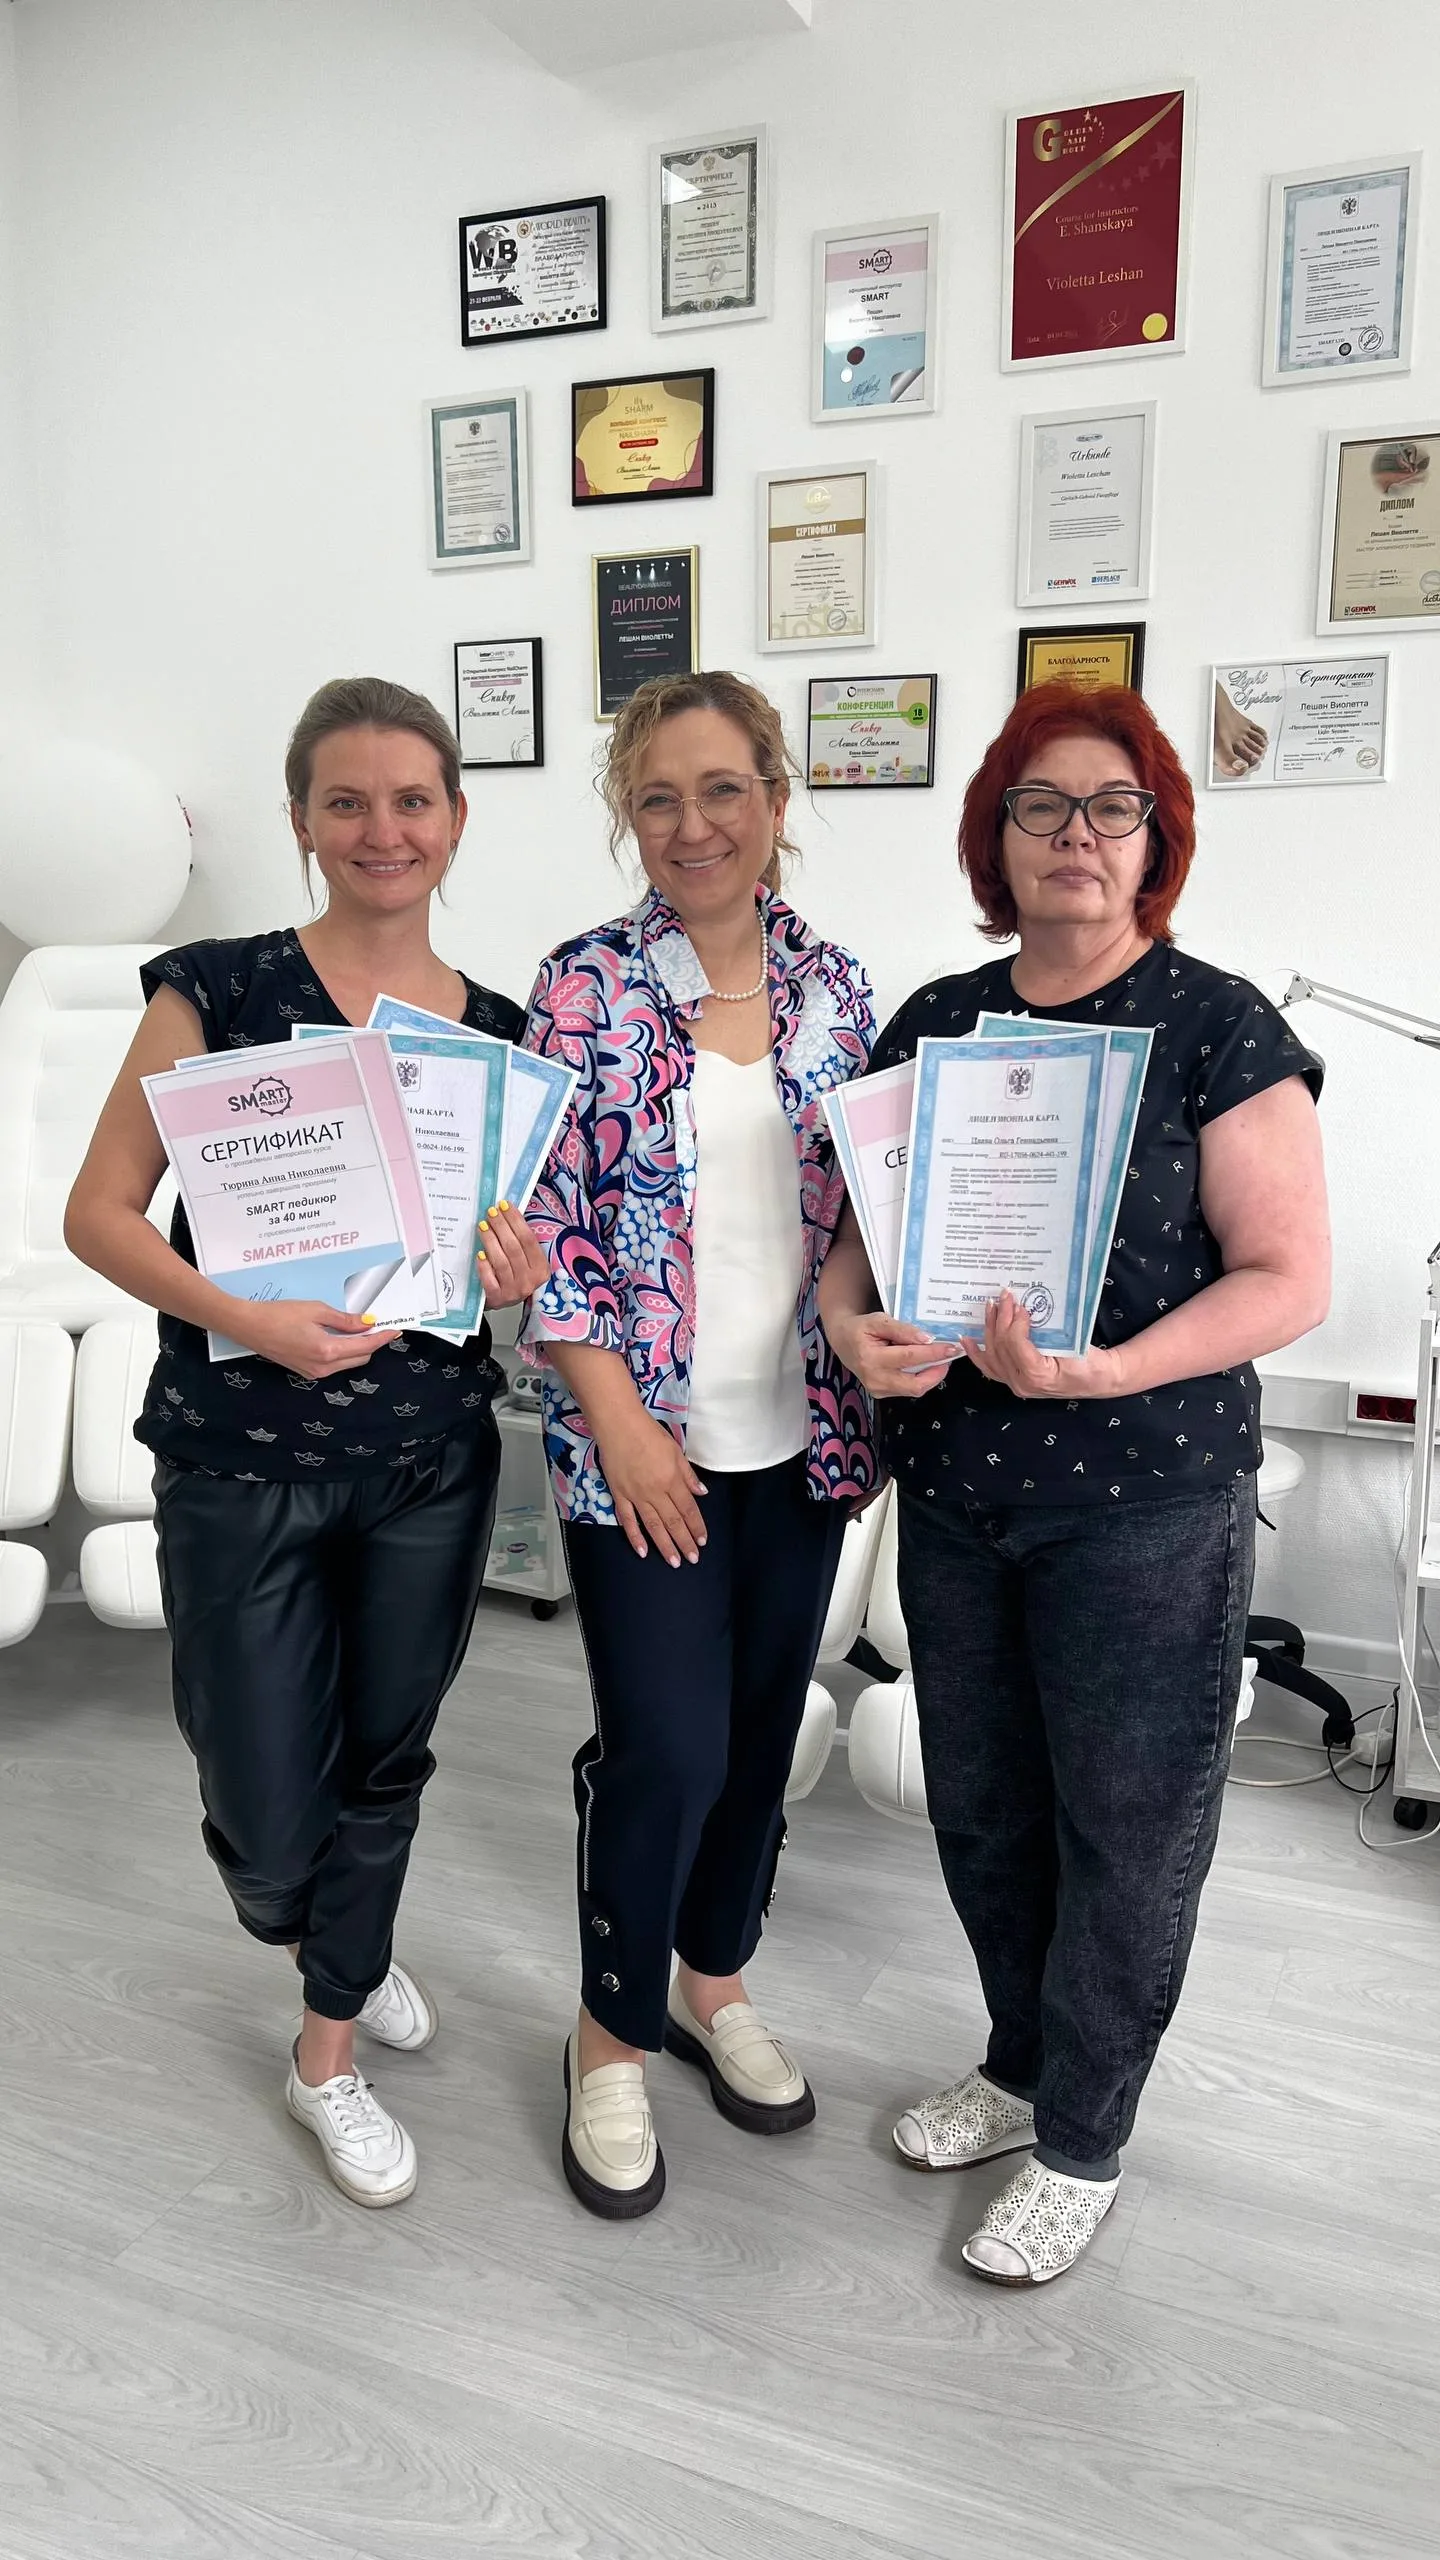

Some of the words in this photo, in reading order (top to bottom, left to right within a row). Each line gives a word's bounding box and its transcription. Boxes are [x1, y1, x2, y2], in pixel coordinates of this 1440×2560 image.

[1055, 212, 1083, 224] Course
[1084, 210, 1096, 220] for
[1097, 204, 1139, 219] Instructors
[1059, 225, 1071, 238] E.
[1073, 216, 1134, 236] Shanskaya
[858, 255, 889, 269] SMART
[1046, 274, 1095, 291] Violetta
[1099, 266, 1144, 284] Leshan
[860, 291, 890, 303] SMART
[624, 403, 654, 415] SHARM
[1069, 446, 1112, 462] Urkunde
[1379, 498, 1415, 512] ДИПЛОМ
[796, 523, 837, 538] СЕРТИФИКАТ
[1053, 577, 1077, 587] GEHWOL
[610, 594, 681, 617] ДИПЛОМ
[1350, 605, 1377, 613] GEHWOL
[618, 635, 641, 643] ЛЕШАН
[640, 633, 674, 642] ВИОЛЕТТЫ
[1047, 656, 1110, 665] БЛАГОДАРНОСТЬ
[1228, 670, 1269, 692] Light
[1296, 668, 1376, 687] Сертификат
[477, 687, 516, 704] Спикер
[1233, 689, 1282, 711] System
[837, 700, 894, 711] КОНФЕРЕНЦИЯ
[1300, 702, 1328, 711] Лешан
[1330, 699, 1369, 709] Виолетта
[913, 708, 923, 717] 18
[848, 721, 882, 735] Спикер
[227, 1086, 286, 1113] SMART
[259, 1096, 288, 1107] master
[426, 1108, 455, 1119] КАРТА
[967, 1114, 1034, 1124] ЛИЦЕНЗИОННАЯ
[1035, 1113, 1061, 1122] КАРТА
[414, 1126, 461, 1139] Николаевна
[201, 1120, 344, 1163] СЕРТИФИКАТ
[994, 1136, 1015, 1145] Ольга
[416, 1142, 466, 1153] 0-0624-166-199
[230, 1154, 273, 1170] прохождении
[273, 1149, 313, 1163] авторского
[313, 1145, 332, 1155] курса
[1128, 1167, 1140, 1179] S
[1173, 1160, 1184, 1173] R
[220, 1177, 260, 1192] Тюрина
[261, 1173, 286, 1185] Анна
[287, 1162, 347, 1181] Николаевна
[236, 1188, 265, 1200] успешно
[301, 1177, 338, 1190] программу
[246, 1200, 285, 1217] SMART
[288, 1192, 338, 1210] педикюр
[268, 1216, 280, 1226] за
[283, 1212, 296, 1223] 40
[298, 1209, 321, 1221] мин
[306, 1219, 336, 1231] статуса
[242, 1242, 295, 1264] SMART
[298, 1230, 360, 1254] МАСТЕР
[1215, 1401, 1225, 1414] S
[1108, 1417, 1121, 1428] P
[1238, 1422, 1248, 1434] A
[1044, 1434, 1057, 1446] S
[1175, 1434, 1189, 1447] R
[986, 1453, 1001, 1466] R
[1073, 1461, 1085, 1474] A
